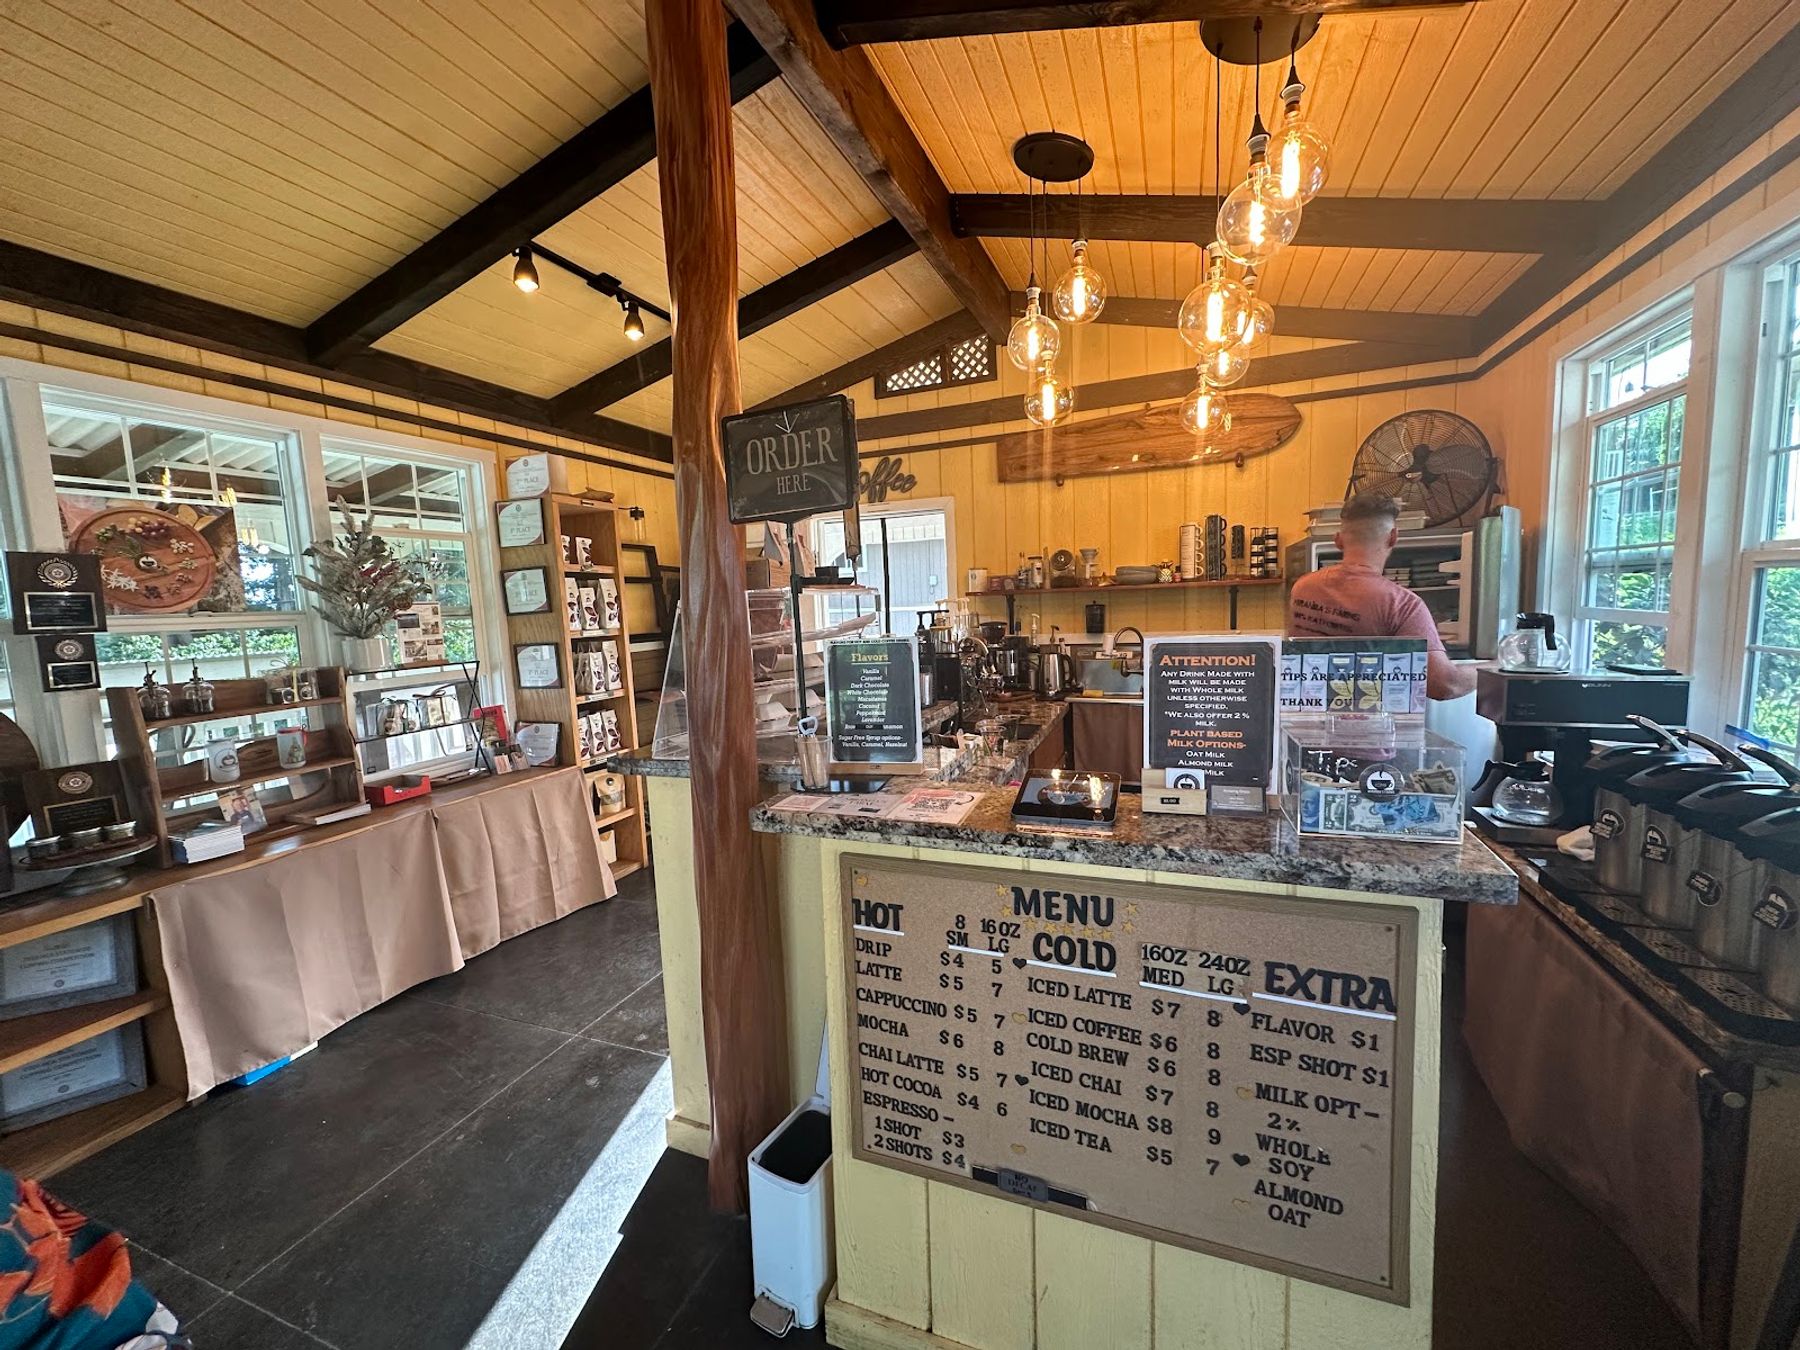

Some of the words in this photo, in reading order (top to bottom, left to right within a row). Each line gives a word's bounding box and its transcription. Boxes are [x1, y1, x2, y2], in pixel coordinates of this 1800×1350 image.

[746, 427, 838, 475] ORDER
[776, 473, 811, 495] HERE
[859, 456, 917, 503] offee
[851, 653, 889, 662] Flavors
[1159, 654, 1256, 666] ATTENTION!
[1280, 673, 1307, 681] TIPS
[1311, 673, 1334, 681] ARE
[1336, 673, 1427, 681] APPRECIATED
[1280, 698, 1323, 706] THANK
[1167, 739, 1193, 747] MILK
[1177, 759, 1213, 767] ALMOND
[852, 898, 903, 931] HOT
[955, 915, 966, 929] 8
[1010, 886, 1114, 927] MENU
[856, 938, 892, 957] DRIP
[991, 959, 1002, 974] 5
[946, 931, 969, 947] SM
[988, 936, 1010, 953] LG
[1032, 932, 1117, 972] COLD
[1141, 944, 1188, 966] 16OZ
[1199, 952, 1251, 976] 24OZ
[856, 960, 902, 981] LATTE
[992, 983, 1002, 997] 7
[1142, 966, 1185, 987] MED
[1207, 976, 1234, 995] LG
[1264, 961, 1397, 1013] EXTRA
[856, 987, 947, 1018] CAPPUCCINO
[994, 1015, 1005, 1029] 7
[1027, 977, 1069, 998] ICED
[1074, 985, 1132, 1010] LATTE
[1207, 1010, 1220, 1027] 8
[857, 1013, 909, 1037] MOCHA
[994, 1040, 1004, 1056] 8
[1027, 1008, 1067, 1029] ICED
[1073, 1016, 1142, 1046] COFFEE
[1207, 1042, 1220, 1060] 8
[1250, 1012, 1335, 1044] FLAVOR
[1352, 1030, 1379, 1051] $1
[858, 1042, 893, 1062] CHAI
[897, 1050, 944, 1075] LATTE
[996, 1073, 1007, 1088] 7
[1027, 1032, 1072, 1055] COLD
[1078, 1042, 1129, 1067] BREW
[1208, 1069, 1221, 1086] 8
[1250, 1044, 1292, 1066] ESP
[1298, 1054, 1356, 1081] SHOT
[1362, 1067, 1389, 1088] $1
[861, 1067, 889, 1086] HOT
[893, 1075, 942, 1099] COCOA
[997, 1102, 1008, 1117] 6
[1031, 1061, 1073, 1083] ICED
[1079, 1073, 1122, 1096] CHAI
[1206, 1101, 1219, 1118] 8
[1255, 1083, 1309, 1109] MILK
[1029, 1089, 1069, 1111] ICED
[1075, 1101, 1139, 1131] MOCHA
[1208, 1128, 1221, 1145] 9
[943, 1131, 965, 1149] $3
[1030, 1117, 1070, 1141] ICED
[1074, 1129, 1112, 1153] TEA
[1206, 1159, 1220, 1176] 7
[1255, 1133, 1331, 1166] WHOLE
[942, 1151, 966, 1169] $4
[1269, 1158, 1315, 1182] SOY
[1254, 1179, 1344, 1216] ALMOND
[1268, 1204, 1311, 1228] OAT
